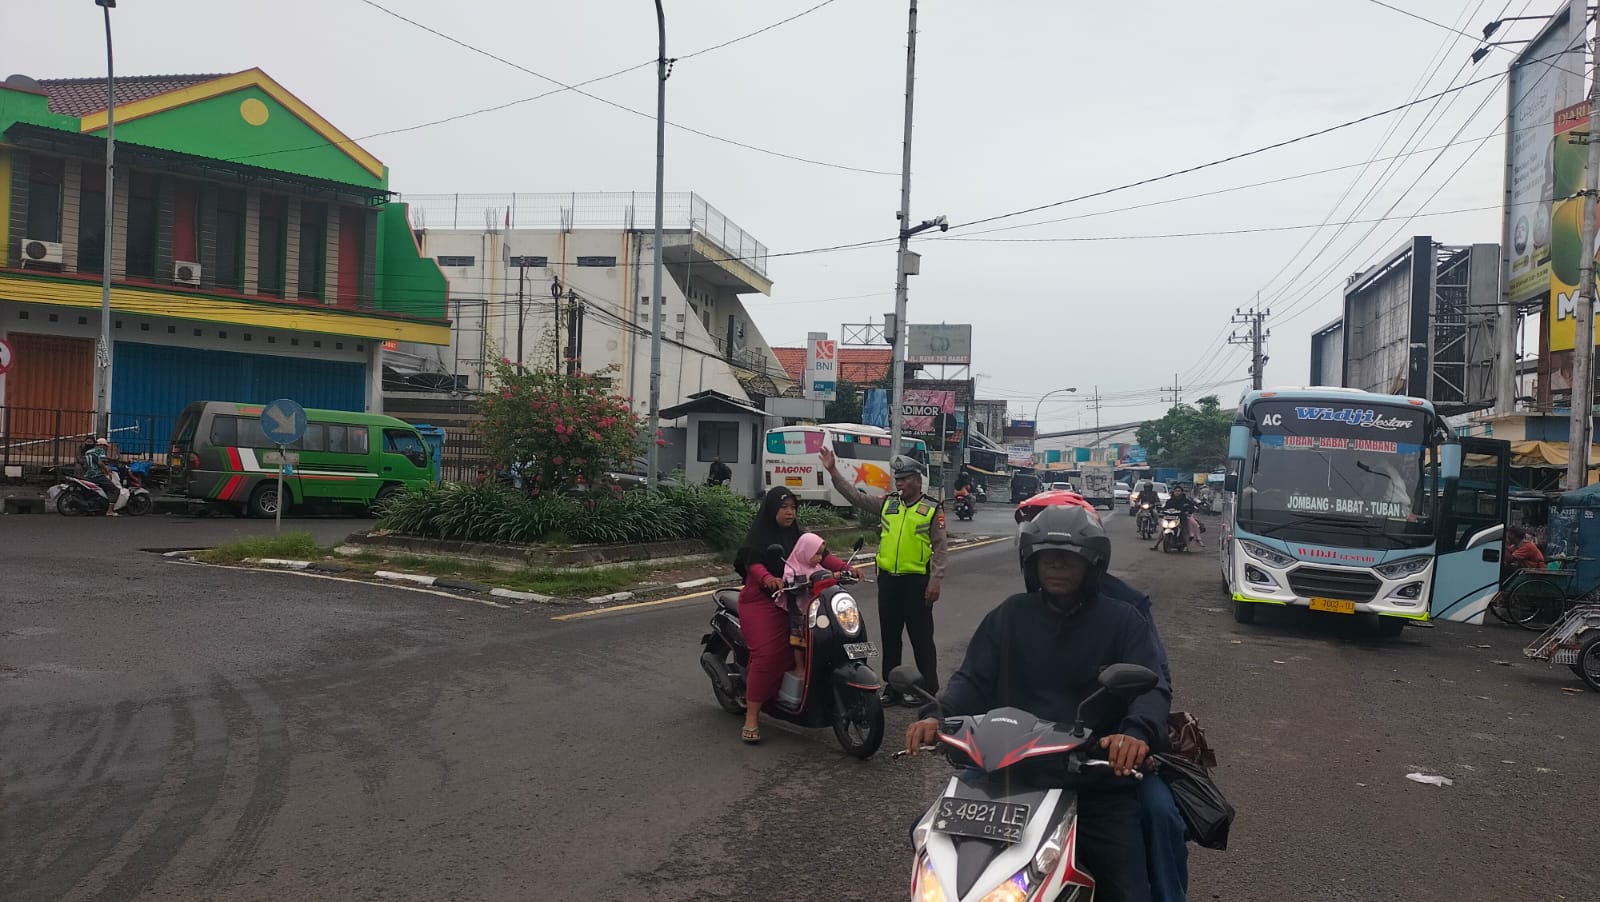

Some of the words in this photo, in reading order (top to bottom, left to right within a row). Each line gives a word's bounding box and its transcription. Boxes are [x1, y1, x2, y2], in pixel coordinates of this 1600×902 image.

[1557, 103, 1591, 128] DJARU
[815, 361, 833, 371] BNI
[1261, 413, 1283, 426] AC
[1295, 406, 1375, 426] Widji
[1284, 435, 1314, 448] TUBAN
[1319, 437, 1349, 450] BABAT
[1354, 439, 1398, 454] JOMBANG
[774, 466, 812, 474] BAGONG
[1287, 496, 1329, 511] JOMBANG
[1335, 499, 1364, 513] BABAT
[1370, 501, 1400, 517] TUBAN
[1297, 547, 1337, 559] WIDJI
[940, 801, 953, 817] S
[955, 803, 997, 822] 4921
[1001, 806, 1025, 826] LE
